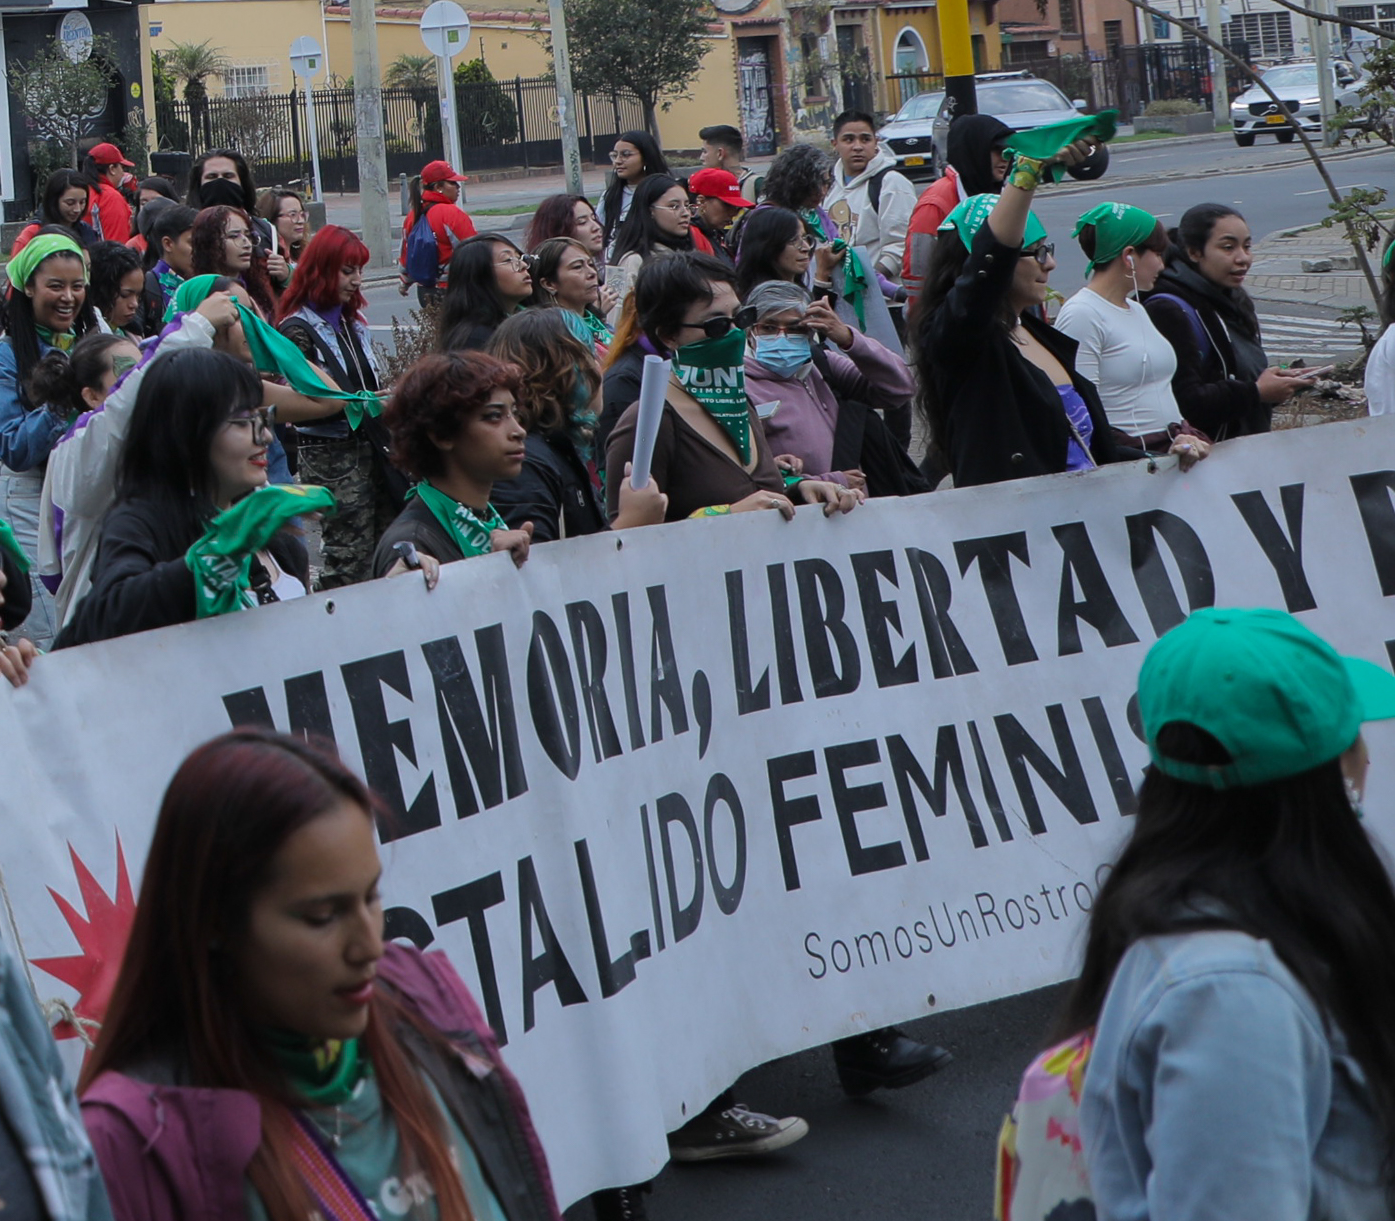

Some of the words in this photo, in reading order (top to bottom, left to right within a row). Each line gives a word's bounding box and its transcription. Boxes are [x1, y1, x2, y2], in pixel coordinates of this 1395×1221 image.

[723, 508, 1216, 716] LIBERTAD
[1230, 482, 1318, 613] Y
[766, 691, 1152, 892] FEMINI
